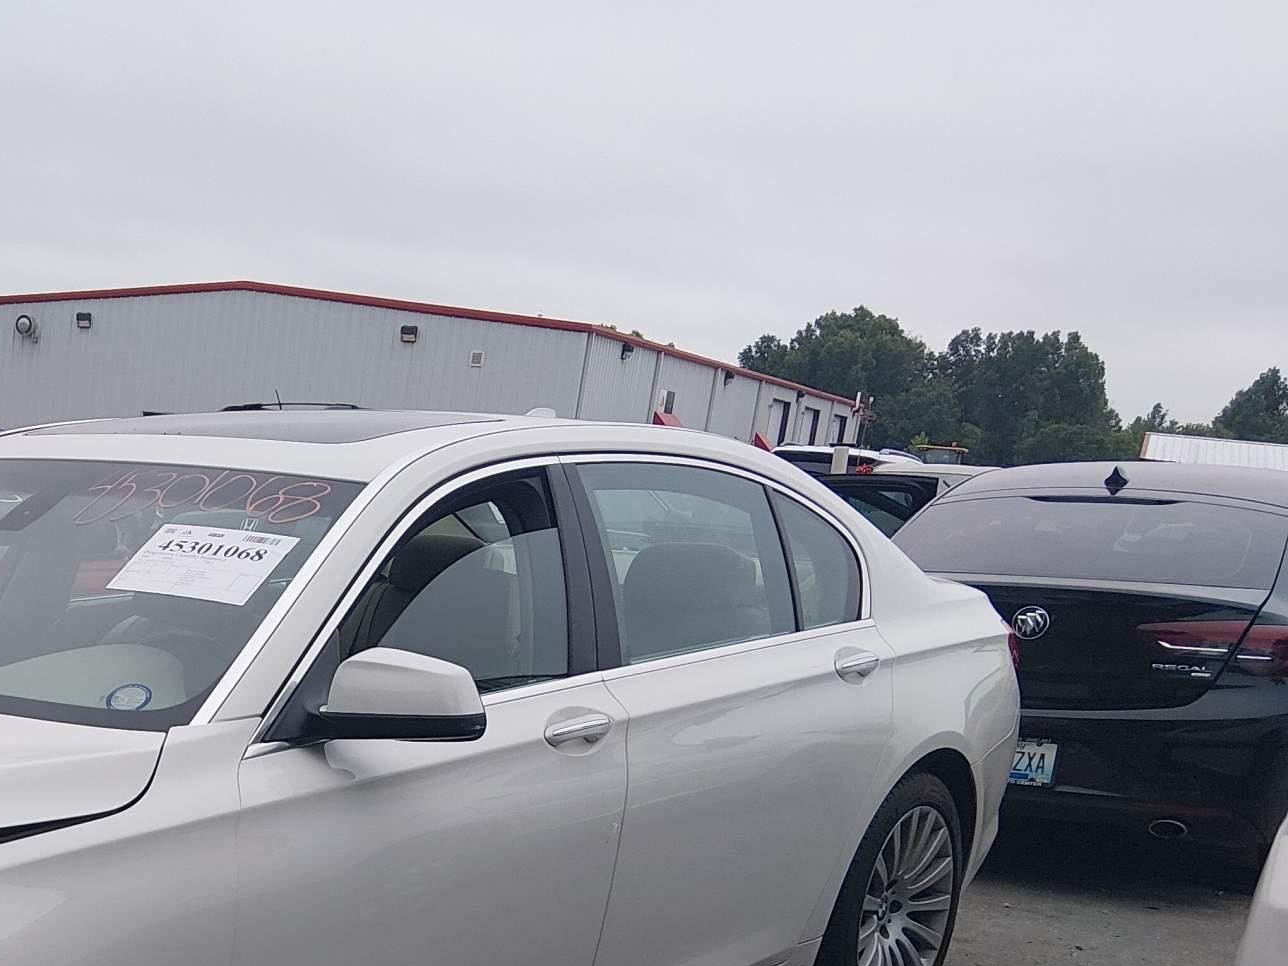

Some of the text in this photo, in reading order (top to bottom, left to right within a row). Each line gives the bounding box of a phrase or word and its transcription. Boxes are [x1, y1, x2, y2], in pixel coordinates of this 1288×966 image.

[158, 538, 268, 562] 45301068
[1151, 663, 1210, 672] REGAL
[1012, 751, 1046, 774] ZXA
